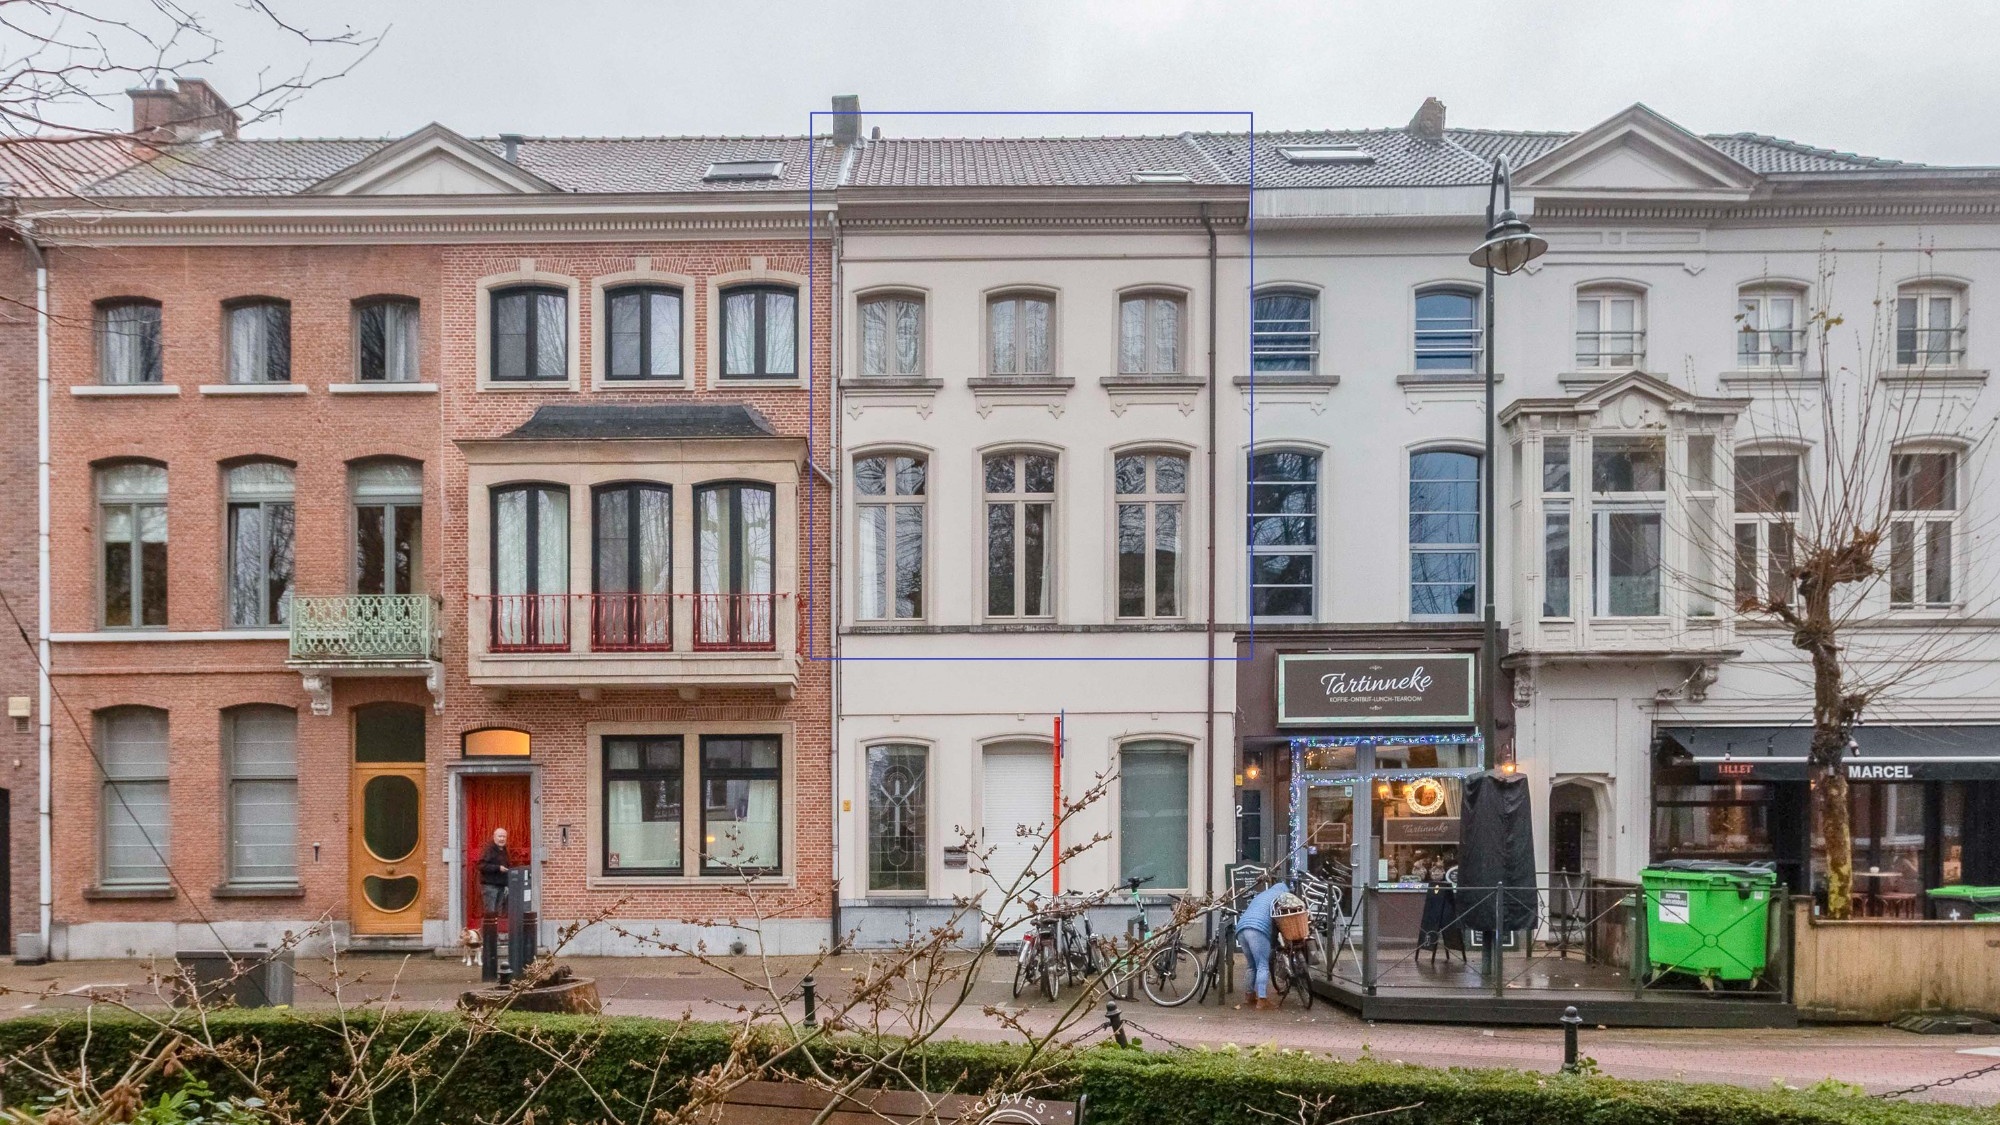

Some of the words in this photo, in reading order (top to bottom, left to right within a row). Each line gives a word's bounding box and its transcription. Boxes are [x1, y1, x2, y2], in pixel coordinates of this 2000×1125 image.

[1320, 666, 1433, 695] Tartinneke
[1718, 764, 1754, 774] LILLET
[1848, 765, 1914, 779] MARCEL
[1236, 805, 1243, 818] 2
[954, 824, 960, 833] 3
